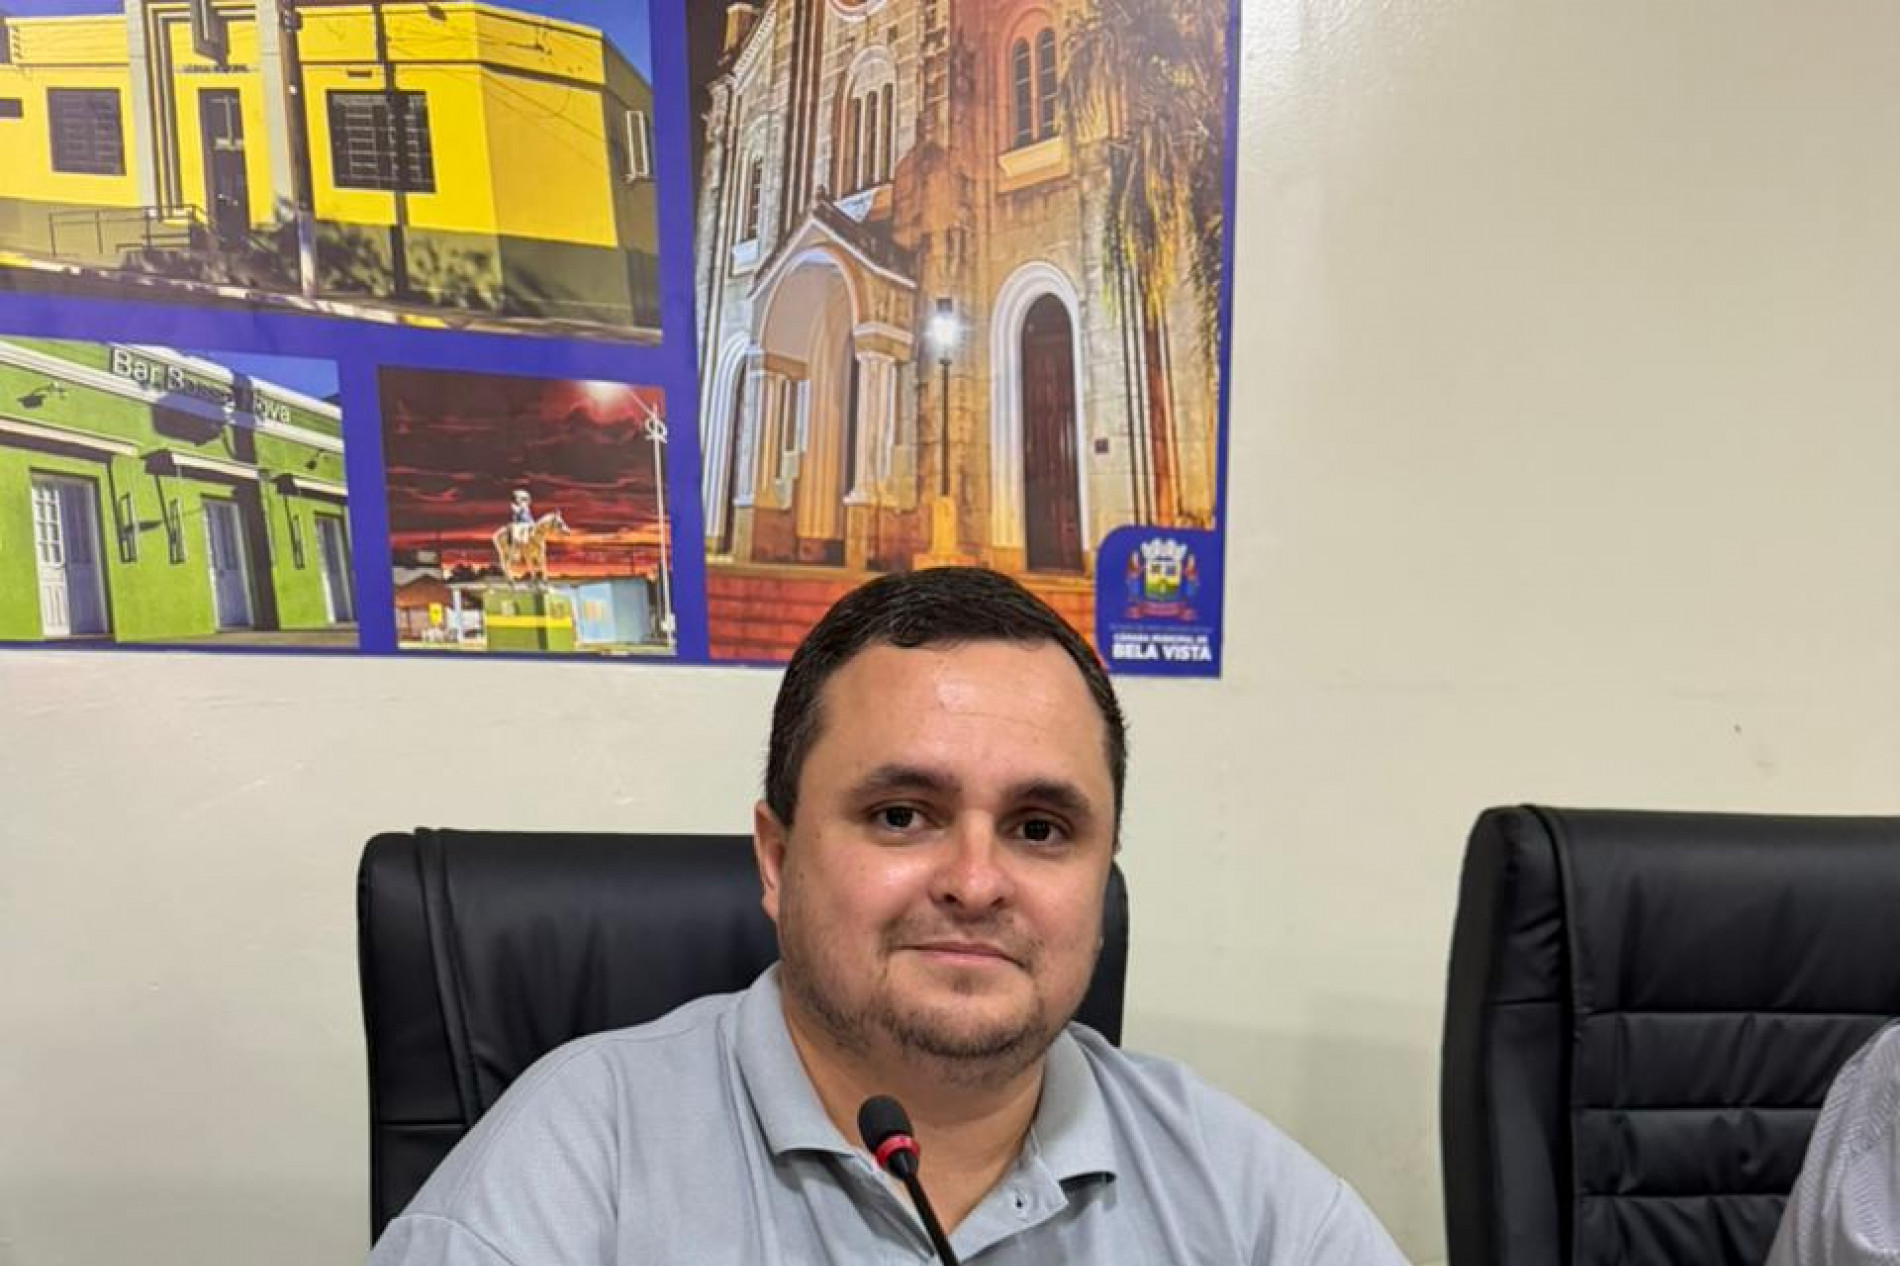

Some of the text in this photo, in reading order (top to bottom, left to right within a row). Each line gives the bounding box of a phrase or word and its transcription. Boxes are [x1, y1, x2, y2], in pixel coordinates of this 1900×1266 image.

[114, 350, 160, 389] Bar
[1112, 643, 1213, 661] BELA VISTA
